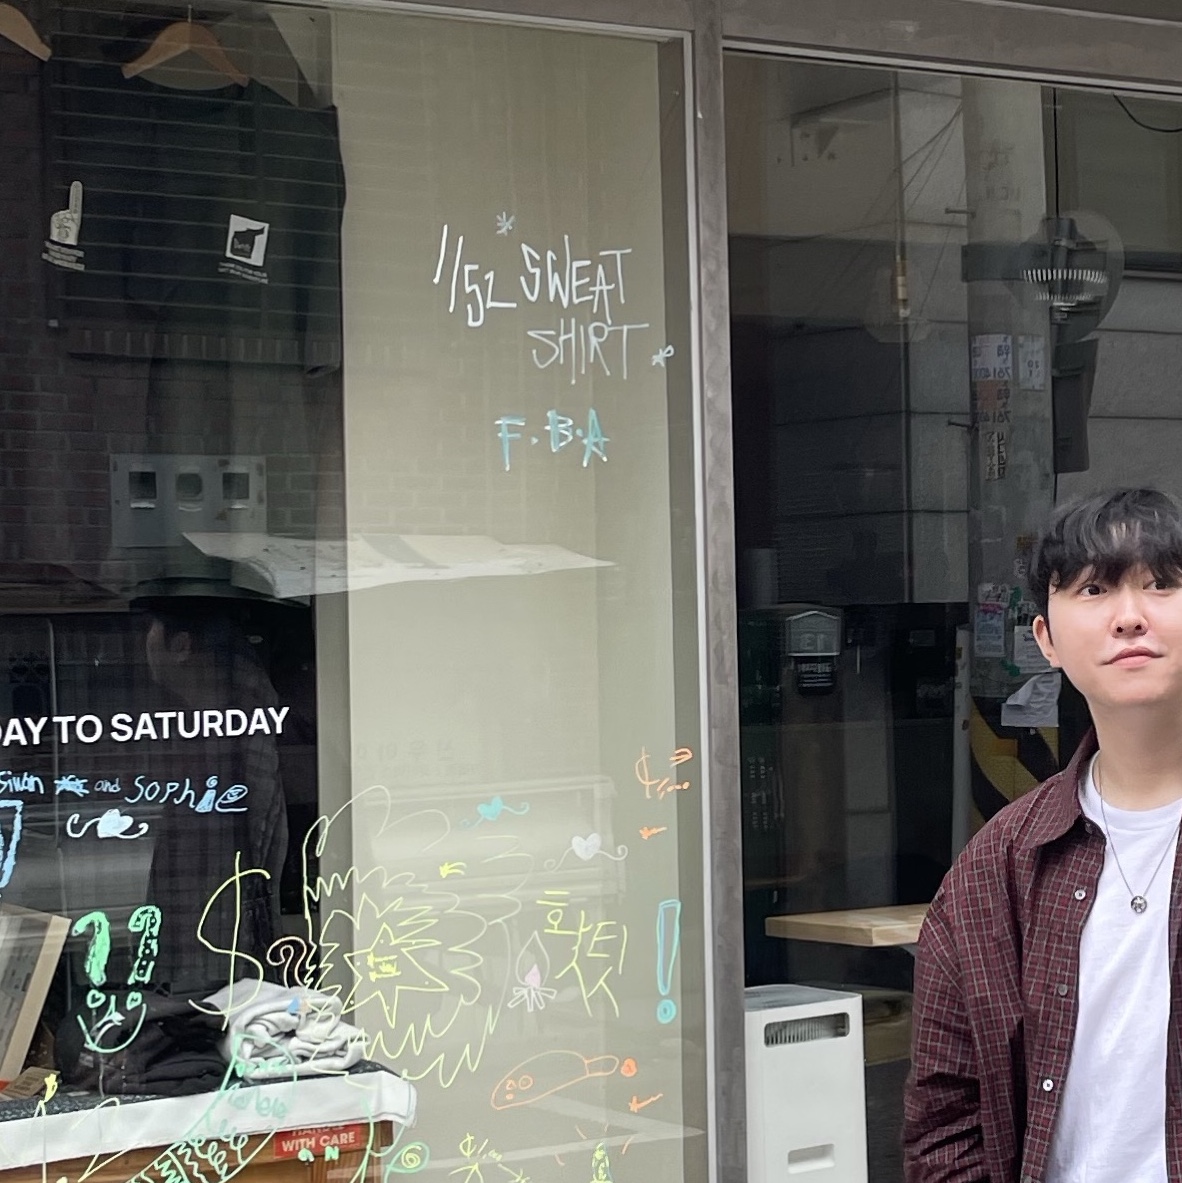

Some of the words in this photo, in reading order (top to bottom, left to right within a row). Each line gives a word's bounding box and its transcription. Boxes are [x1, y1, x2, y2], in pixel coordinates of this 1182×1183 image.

[519, 233, 633, 326] SWEAT
[526, 317, 650, 385] SHIRT
[0, 716, 48, 747] AY
[52, 714, 103, 744] TO
[110, 706, 290, 742] SATURDAY
[94, 778, 122, 794] and
[281, 1137, 316, 1152] WITH
[319, 1130, 356, 1147] CARE
